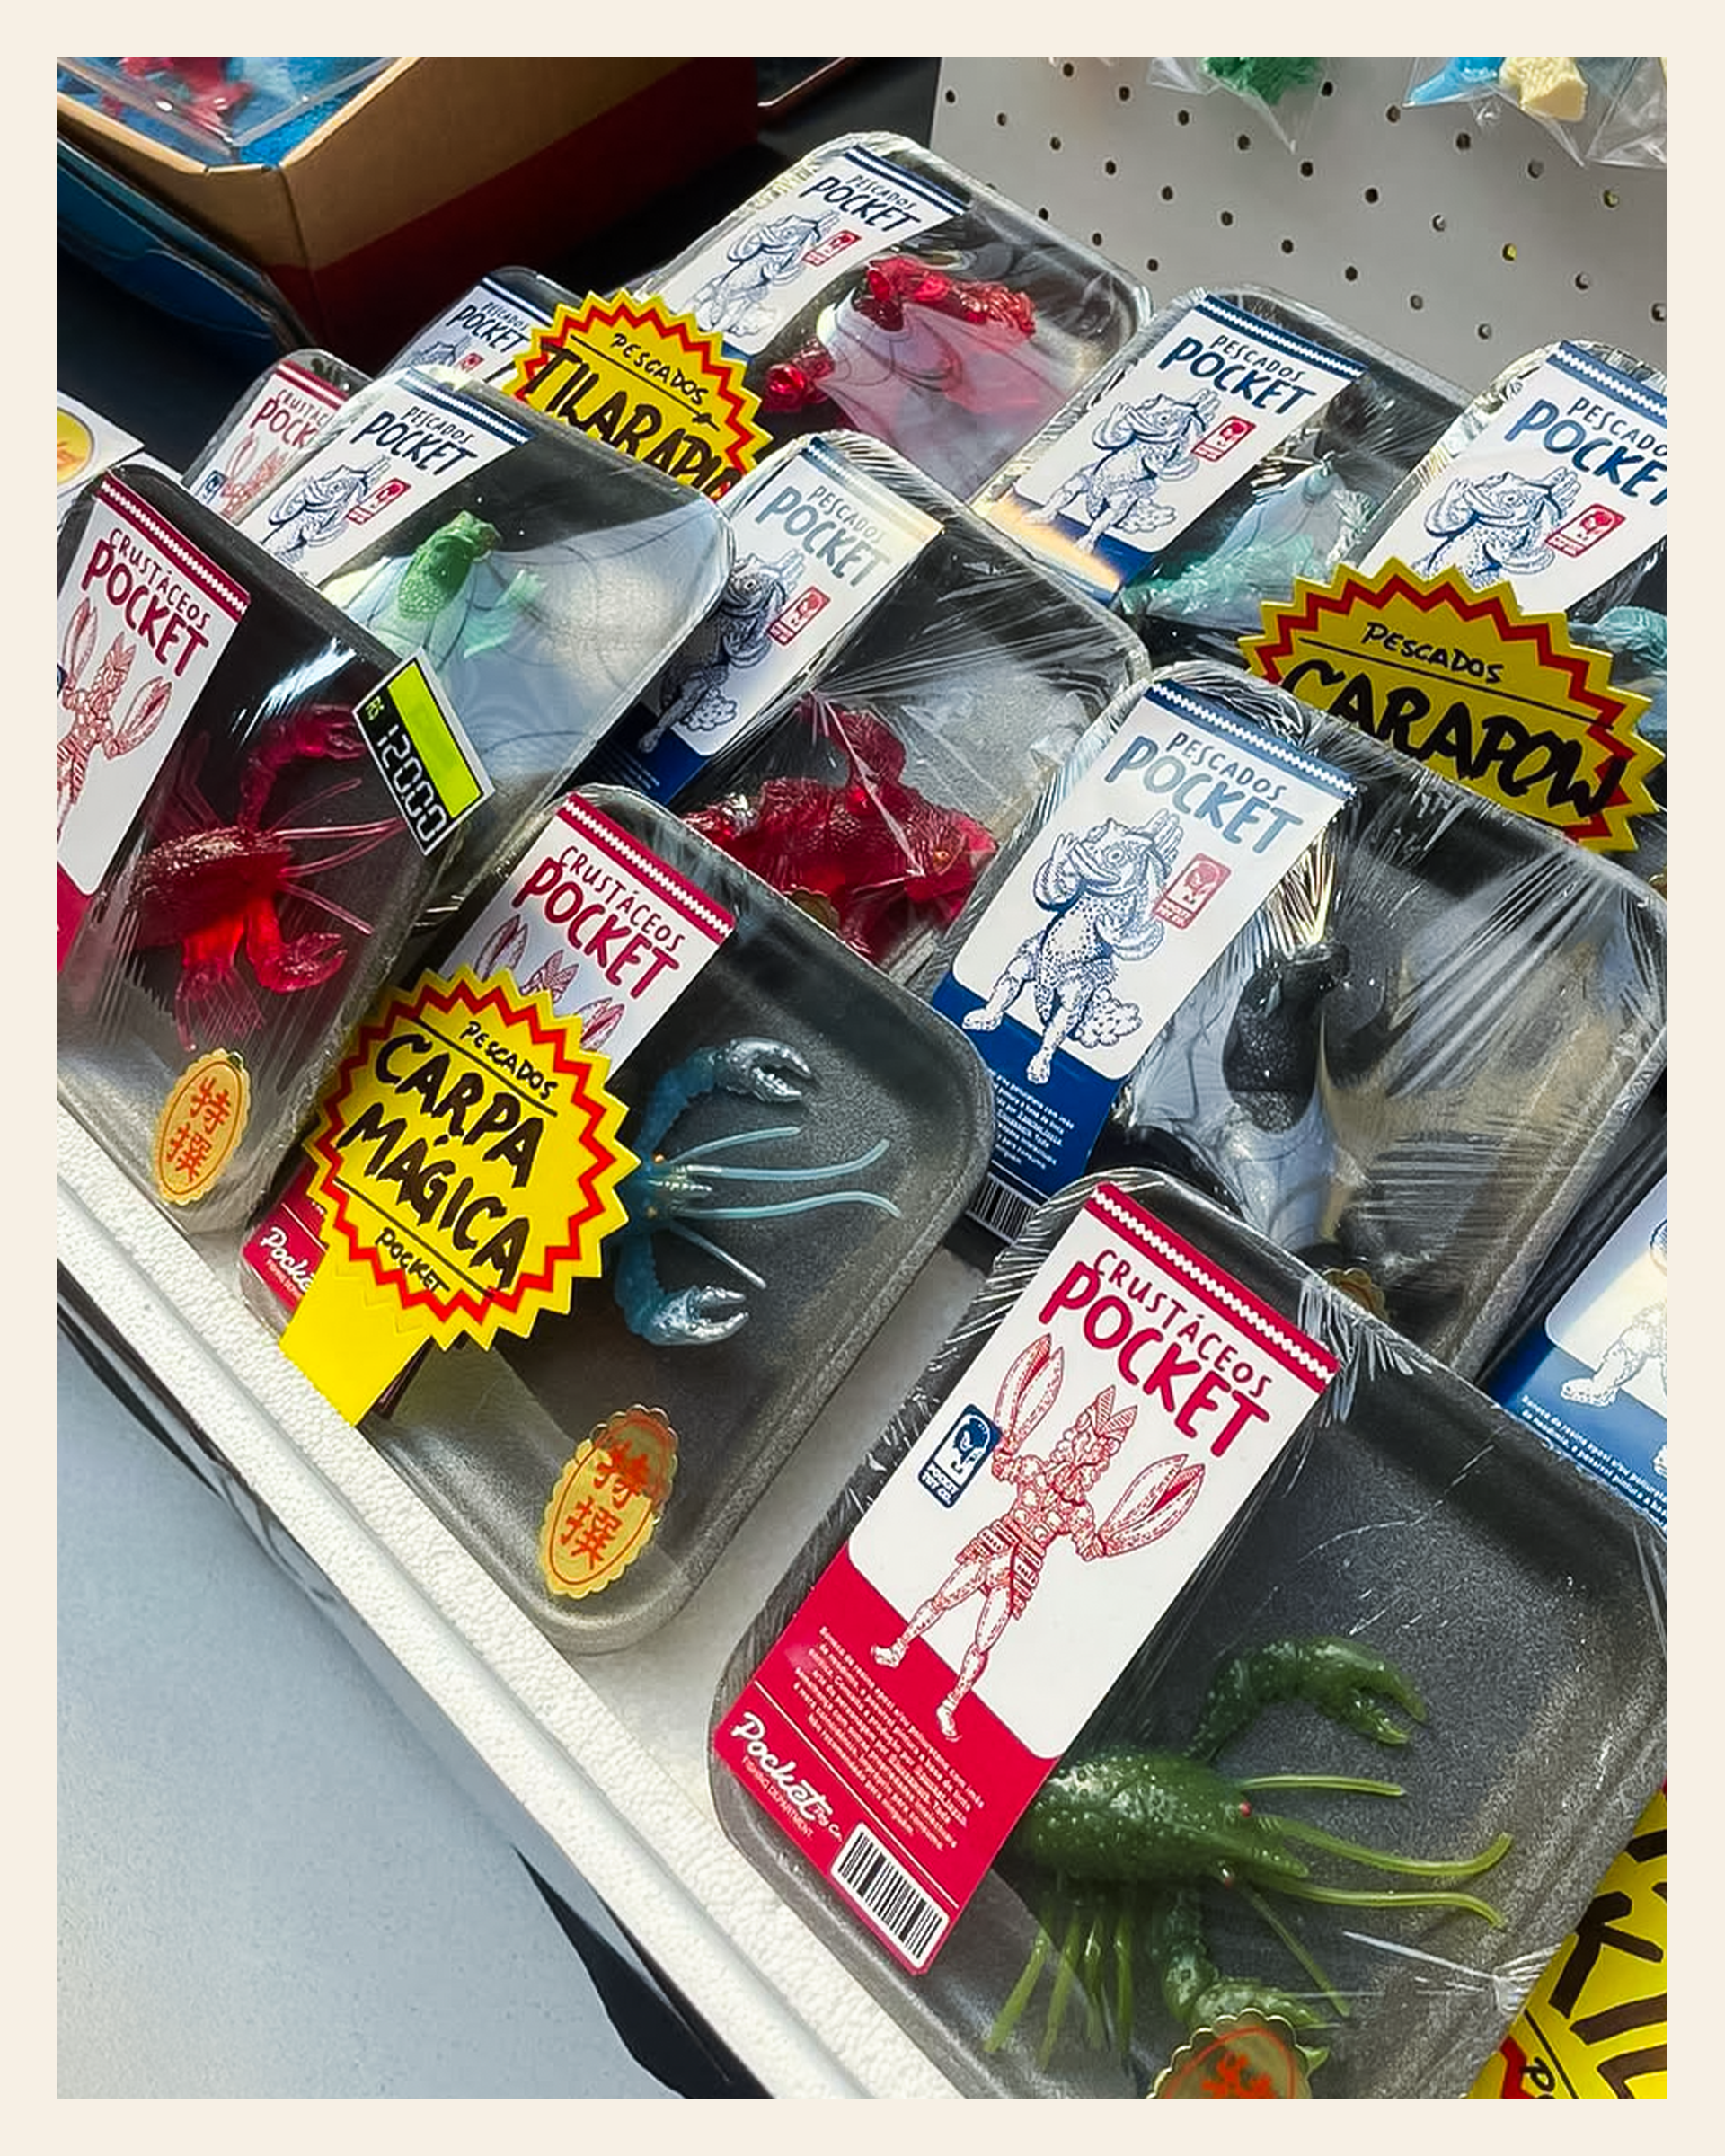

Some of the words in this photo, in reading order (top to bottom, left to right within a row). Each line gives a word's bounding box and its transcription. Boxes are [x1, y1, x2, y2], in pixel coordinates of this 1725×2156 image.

[799, 176, 921, 232] POCKET
[848, 175, 916, 209] PESCADOS
[446, 305, 531, 353] POCKET
[1210, 335, 1304, 382] PESCADOS
[611, 333, 708, 404] PESCADOS
[1158, 336, 1316, 415] POCKET
[250, 398, 319, 448] POCK
[277, 389, 329, 426] CRUSTÁC
[349, 411, 477, 475] POCKET
[401, 406, 475, 445] PESCADOS
[1567, 396, 1668, 456] PESCADO
[755, 486, 891, 588] POCKET
[807, 485, 886, 543] PESCADOS
[81, 540, 208, 677] POCKET
[110, 527, 210, 629] CRUSTÁCEOS
[1361, 622, 1505, 685] PESCADOS
[1167, 731, 1287, 801] PESCADOS
[1282, 659, 1627, 819] CARAPOW
[1104, 735, 1304, 854] POCKET
[511, 855, 680, 1000] POCKET
[558, 844, 686, 952] CRUSTÁCEOS
[459, 1021, 559, 1100] PESCADOS
[374, 1033, 545, 1188] CARPA
[337, 1103, 532, 1290] MÁGICA
[261, 1226, 315, 1293] Pocke
[375, 1227, 451, 1294] POCKET
[1092, 1249, 1272, 1397] CRUSTÁCEOS
[1038, 1260, 1270, 1458] POCKET
[731, 1710, 834, 1821] Pocket
